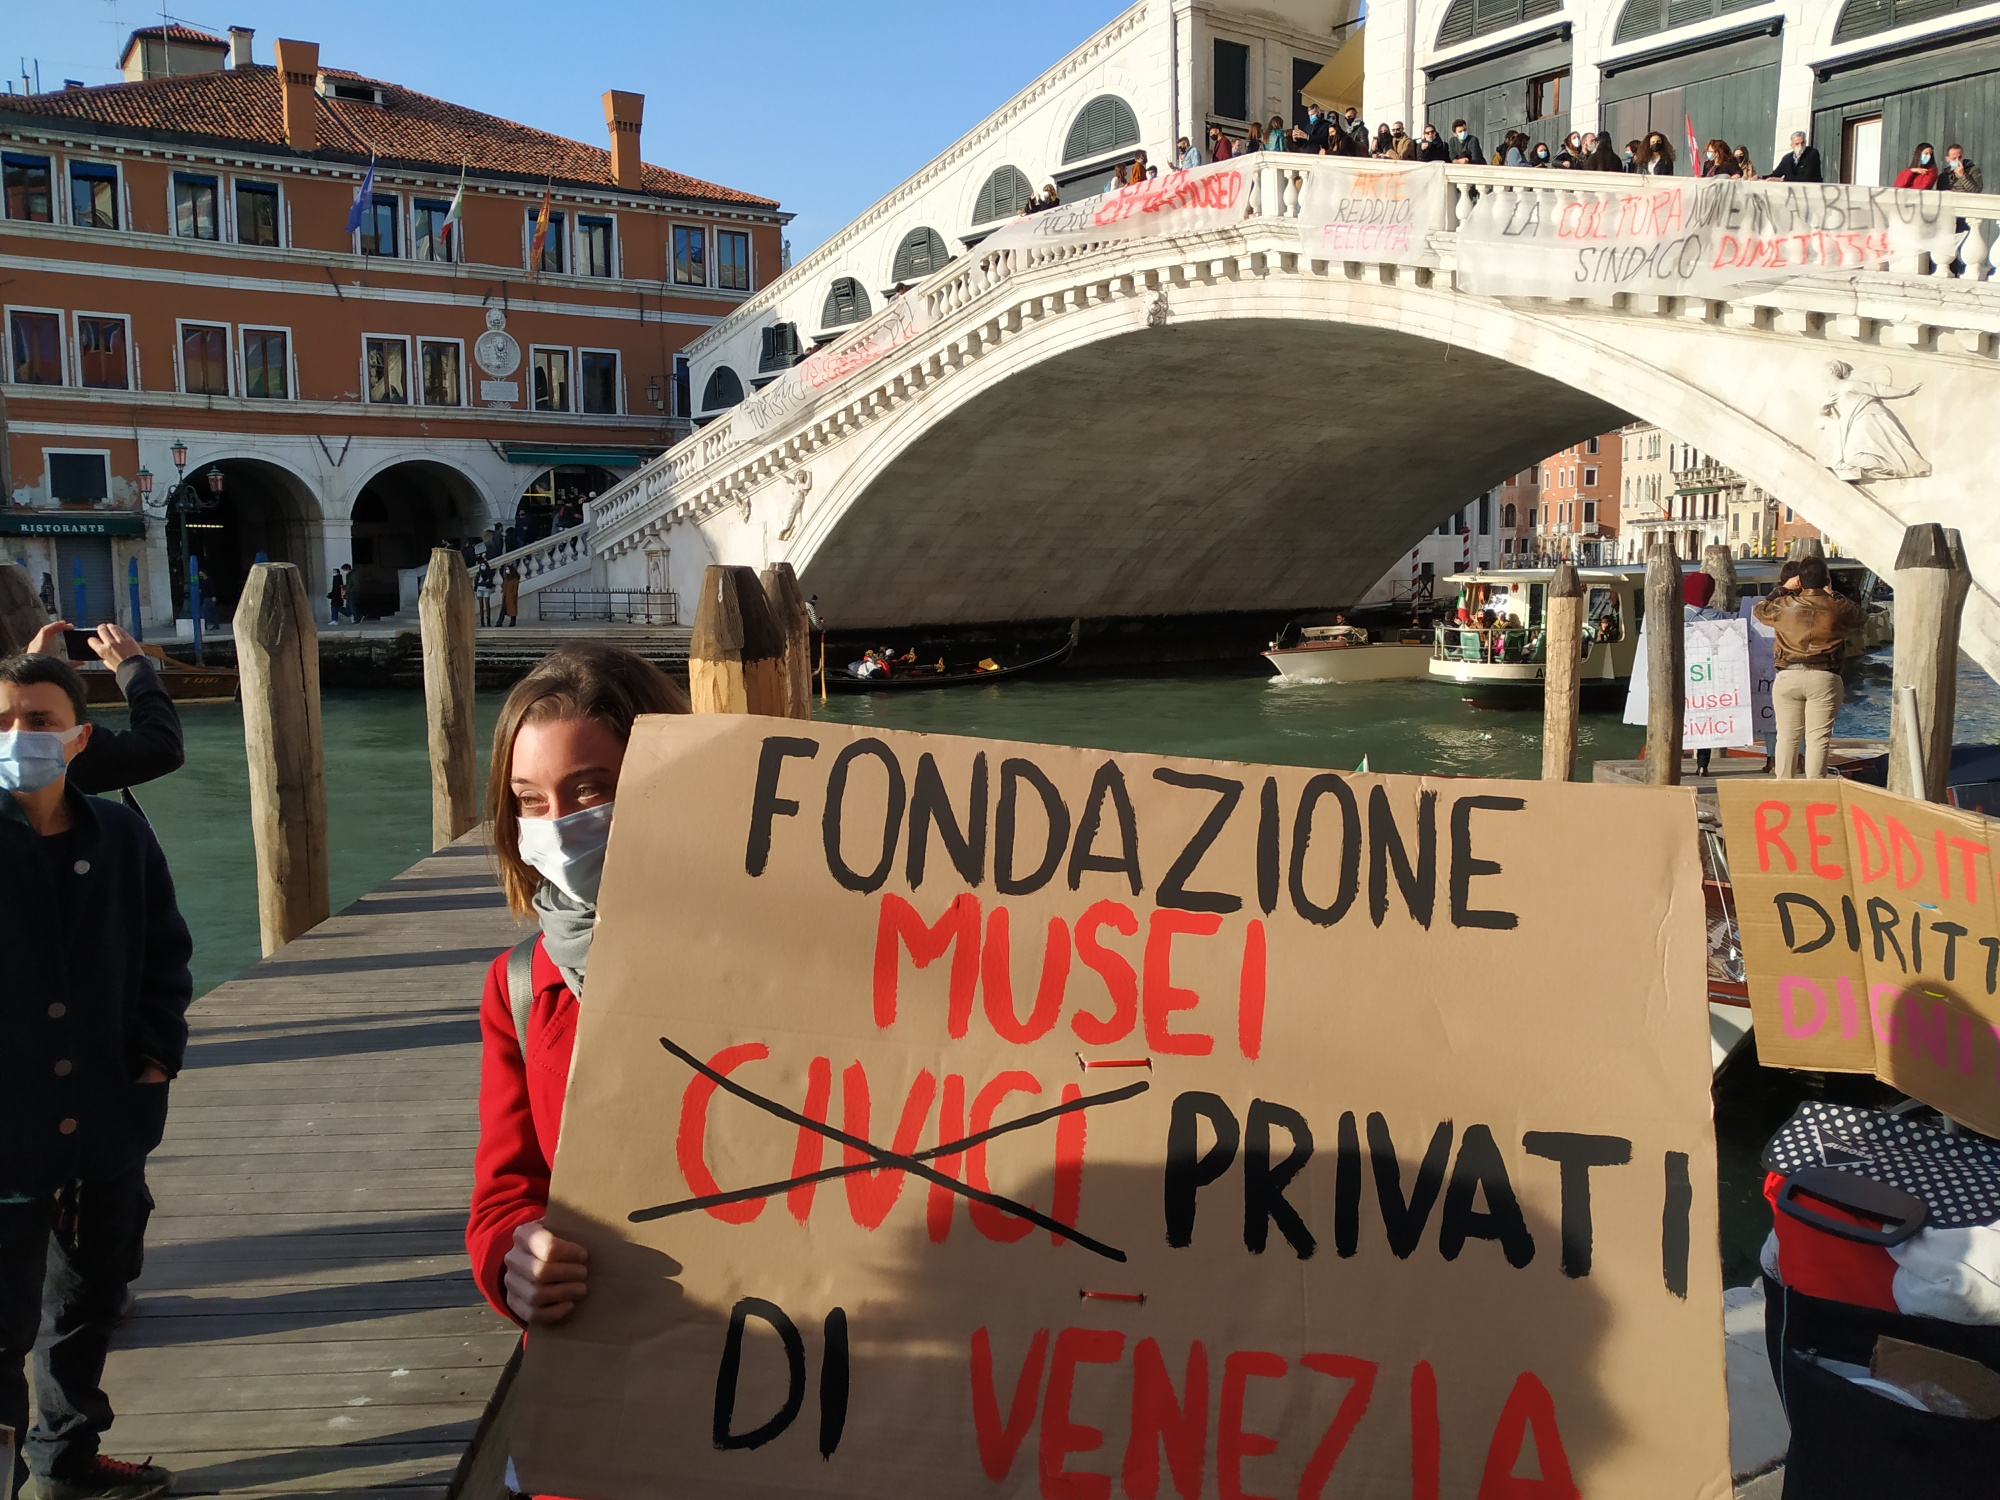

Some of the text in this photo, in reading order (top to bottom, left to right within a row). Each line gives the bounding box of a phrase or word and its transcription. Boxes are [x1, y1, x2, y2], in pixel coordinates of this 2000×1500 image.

[1503, 201, 1540, 237] LA
[1557, 188, 1683, 239] CULTURA
[1575, 234, 1702, 284] SINDACO
[20, 524, 105, 533] RISTORANTE
[1690, 657, 1712, 682] si
[745, 736, 1527, 931] FONDAZIONE
[1754, 800, 2000, 905] REDDIT
[873, 892, 1267, 1063] MUSEI
[676, 1042, 1693, 1301] CIVICI PRIVATI
[1823, 1142, 1874, 1160] AURORA
[713, 1296, 1584, 1500] DI VENEZIA
